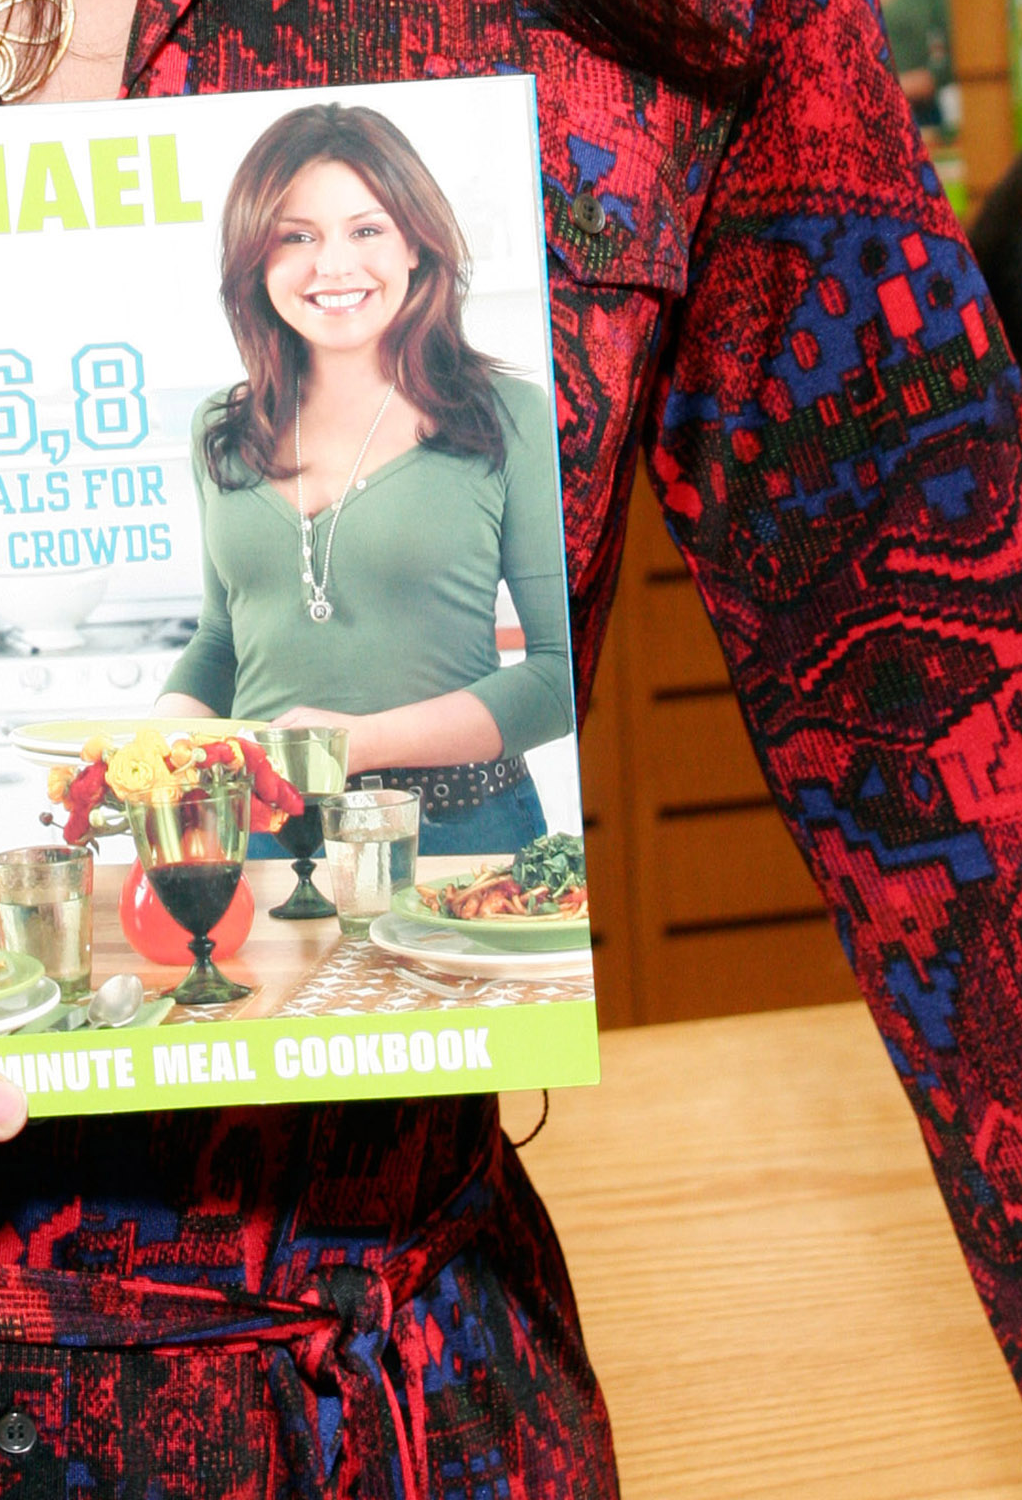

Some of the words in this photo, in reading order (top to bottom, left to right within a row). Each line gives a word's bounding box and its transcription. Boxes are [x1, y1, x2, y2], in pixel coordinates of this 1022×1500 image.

[82, 465, 167, 509] FOR
[8, 523, 172, 569] CROWDS
[153, 1040, 257, 1087] MEAL
[274, 1026, 494, 1080] COOKBOOK
